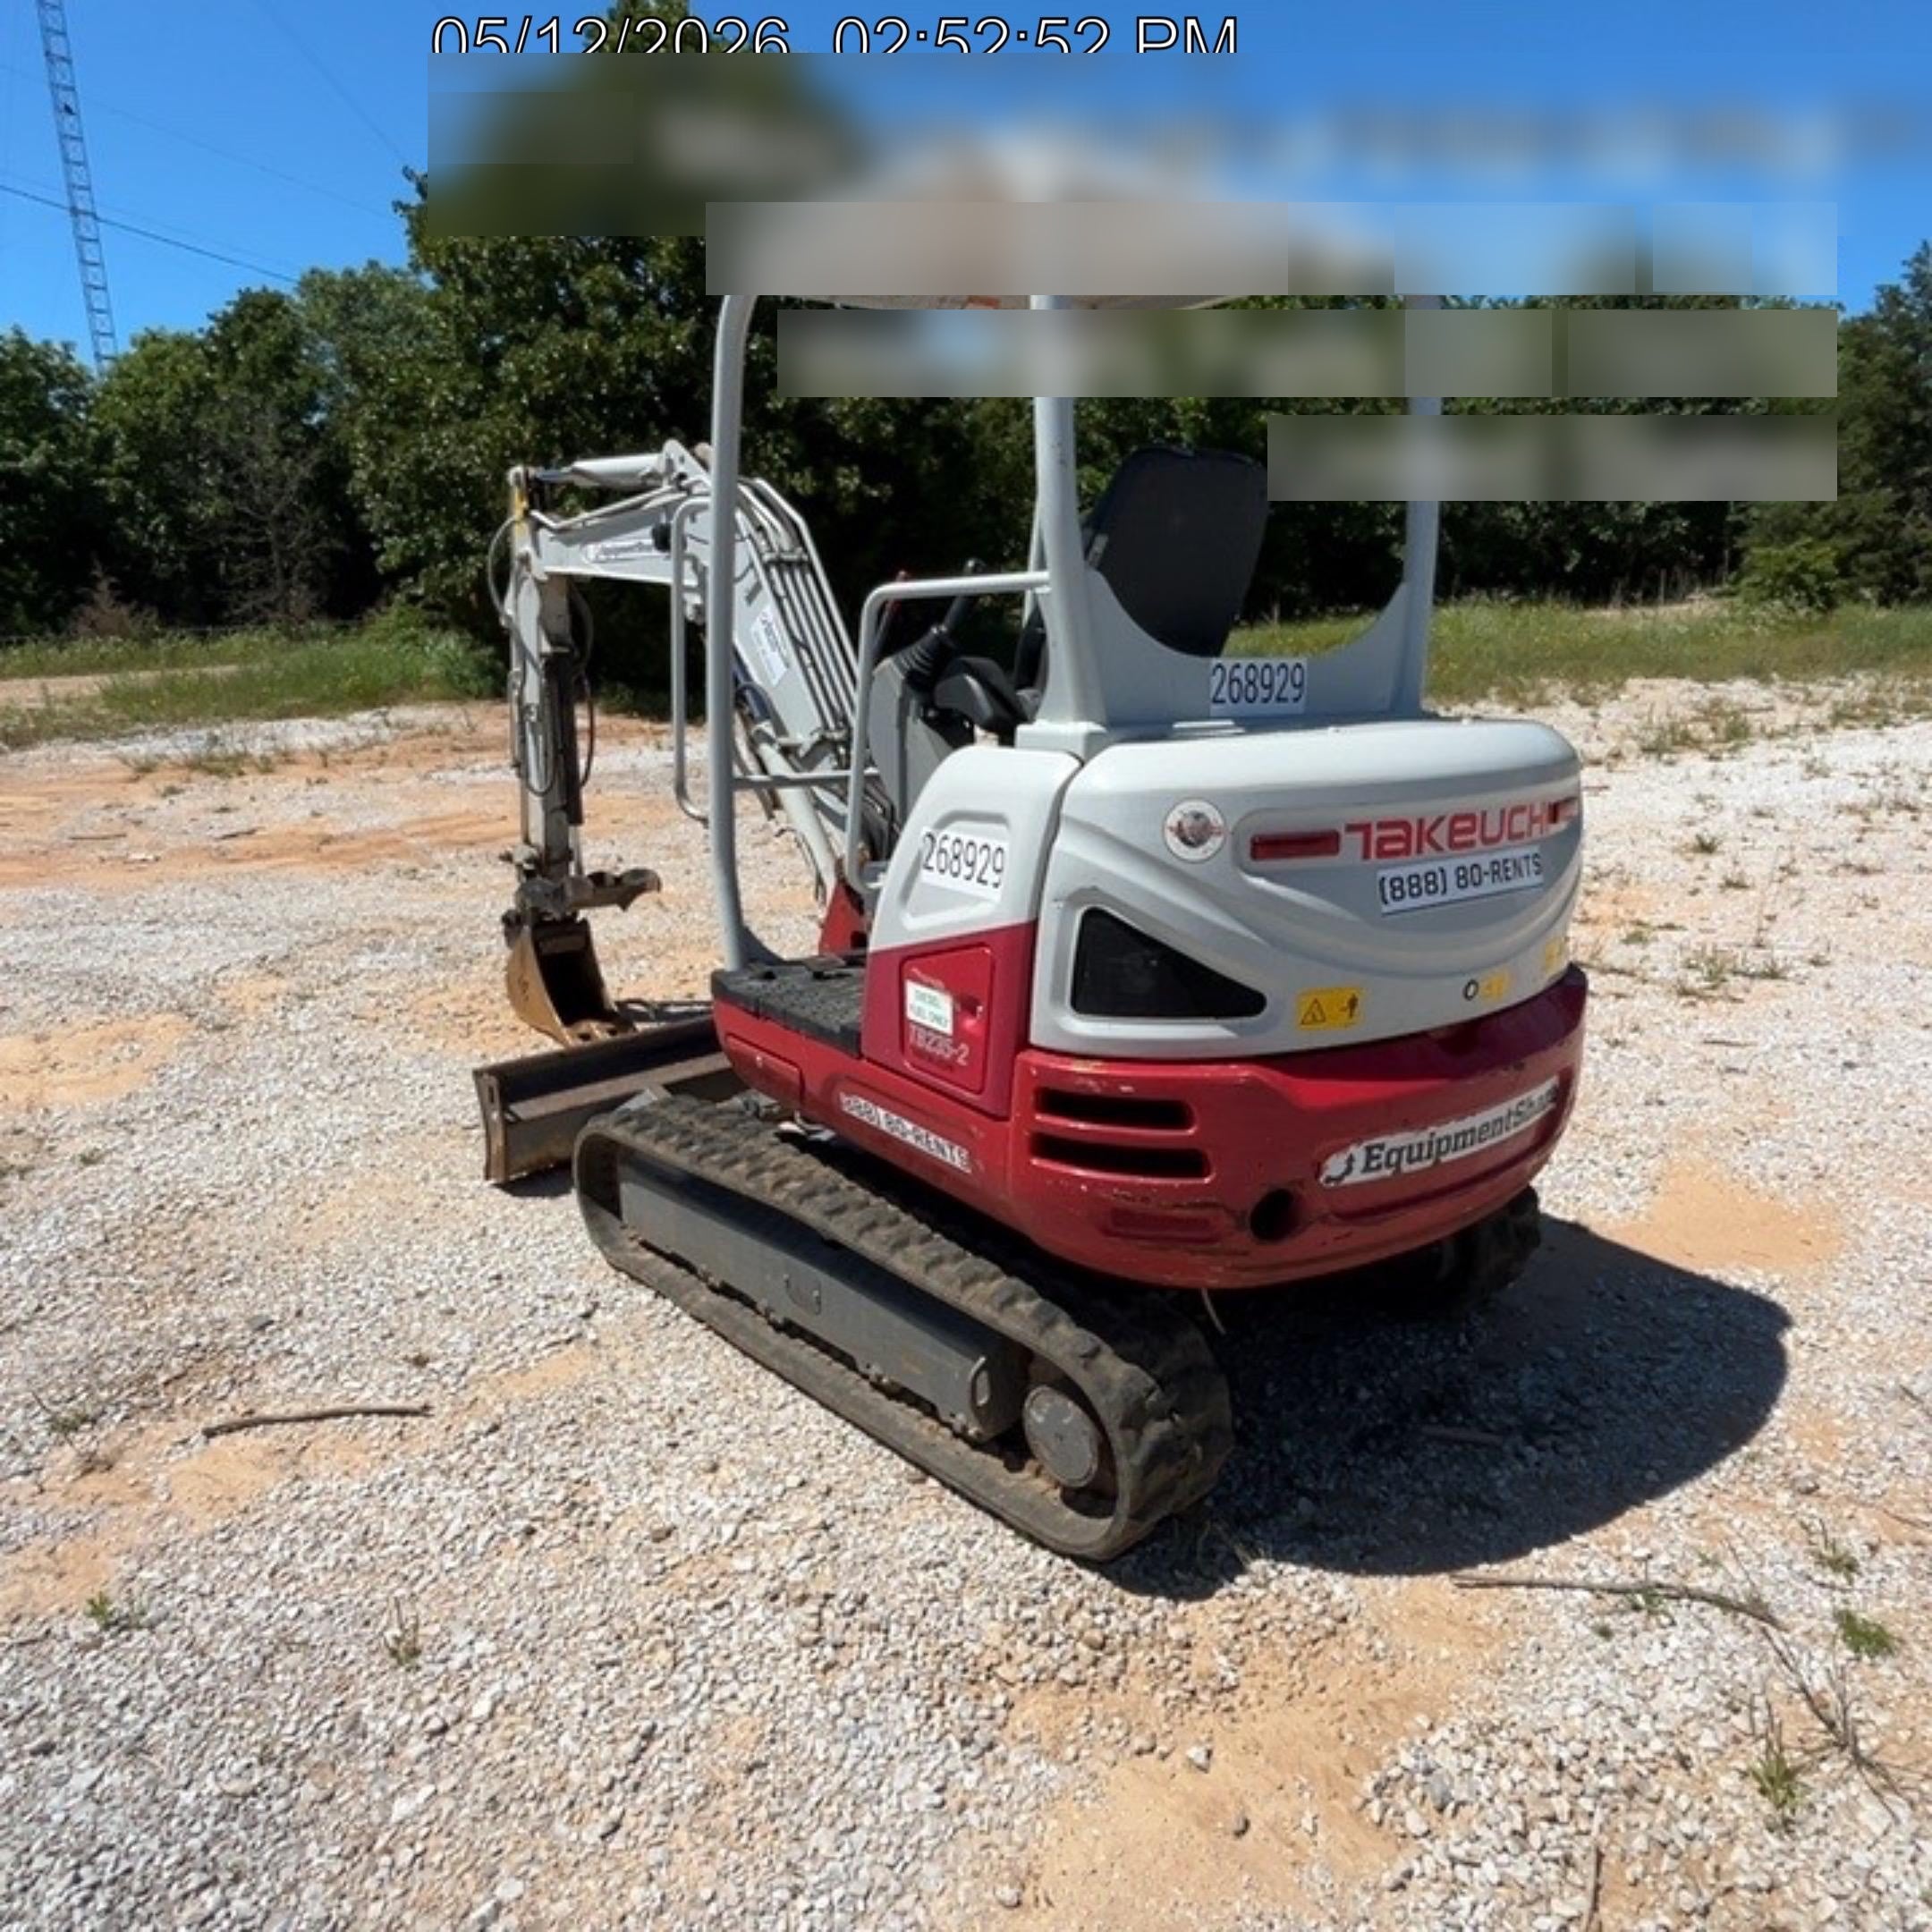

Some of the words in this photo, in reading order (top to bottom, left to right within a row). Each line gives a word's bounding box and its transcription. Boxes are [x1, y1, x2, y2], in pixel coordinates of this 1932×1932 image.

[1211, 662, 1305, 704] 268929
[922, 831, 1004, 889] 268929
[1378, 866, 1447, 904] (888)
[1455, 852, 1543, 890] 80-RENTS
[1361, 1084, 1558, 1176] EquipmentSha
